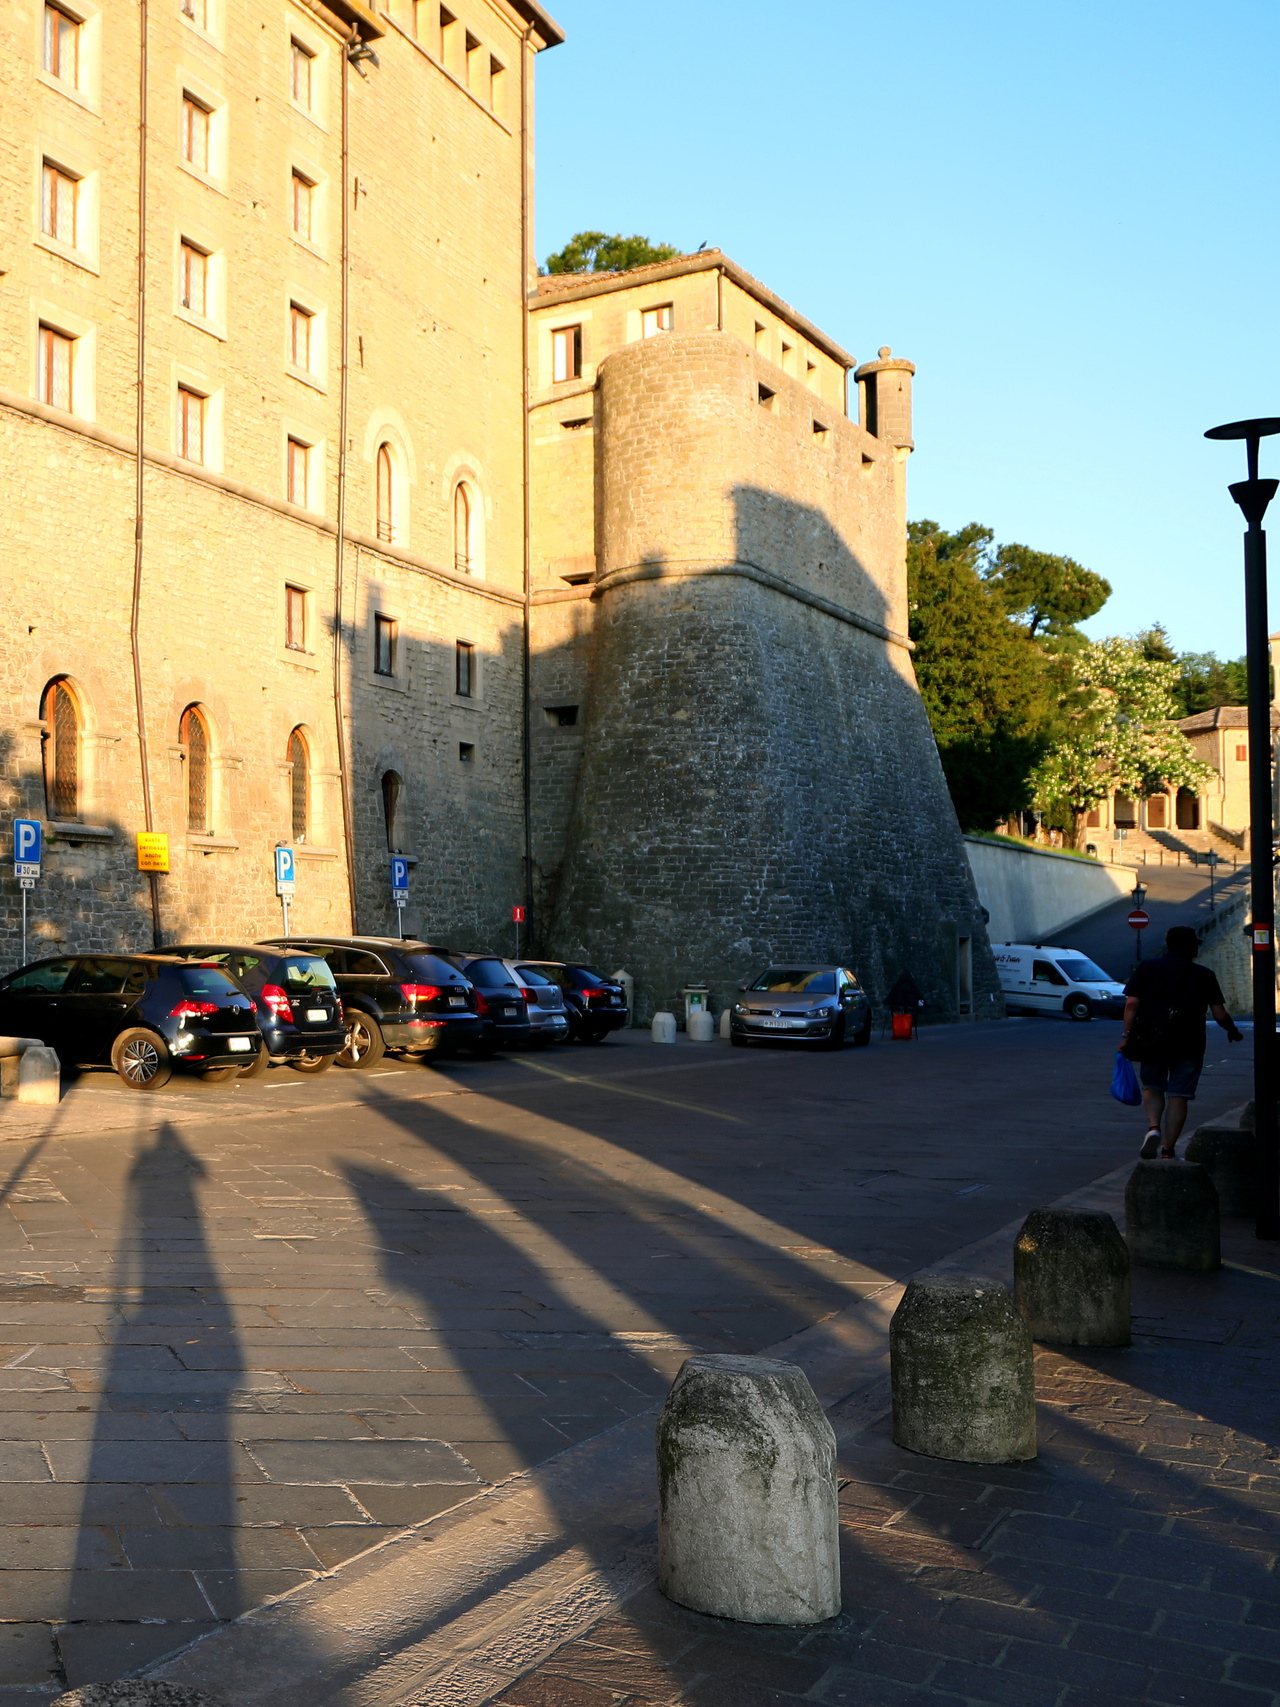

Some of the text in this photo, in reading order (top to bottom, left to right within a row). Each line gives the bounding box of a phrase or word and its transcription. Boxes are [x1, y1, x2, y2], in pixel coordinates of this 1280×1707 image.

[20, 824, 36, 858] P
[22, 866, 31, 875] 30
[280, 851, 291, 879] P
[395, 862, 405, 885] P
